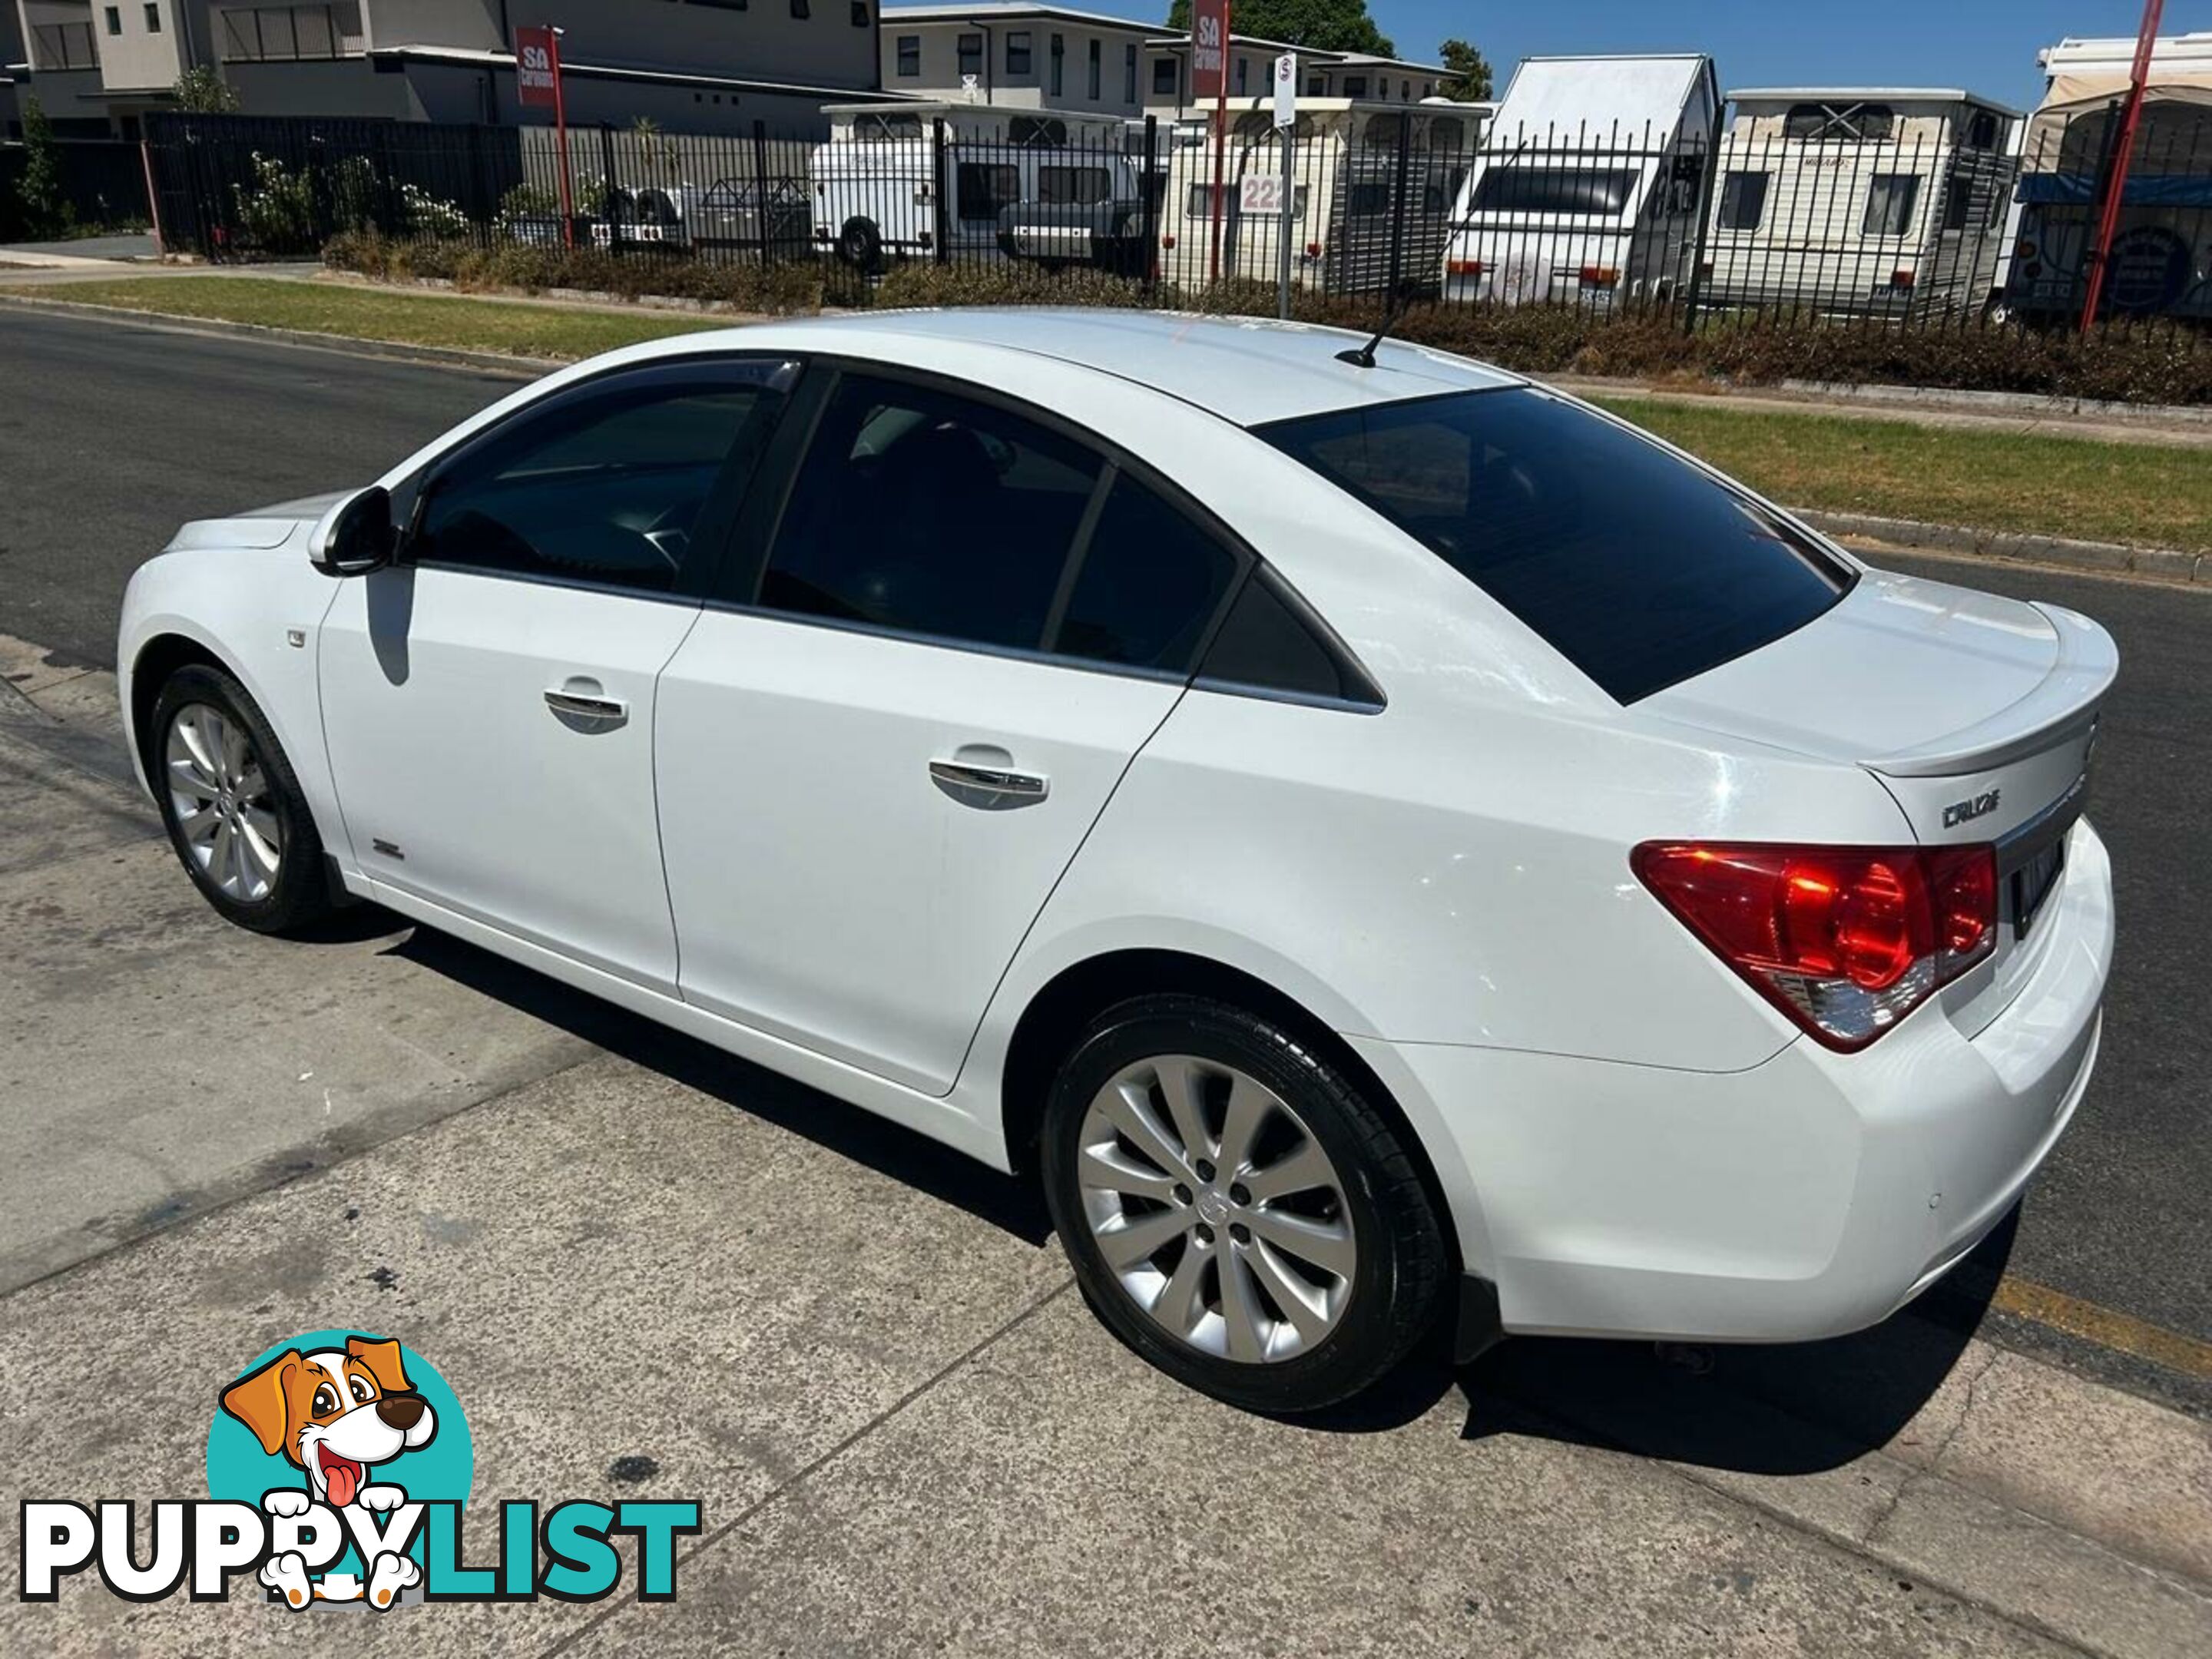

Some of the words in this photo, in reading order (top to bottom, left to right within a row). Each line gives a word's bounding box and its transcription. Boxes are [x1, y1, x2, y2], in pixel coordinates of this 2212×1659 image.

[1199, 16, 1219, 46] SA
[523, 47, 549, 69] SA
[1942, 789, 2000, 830] CRUZE
